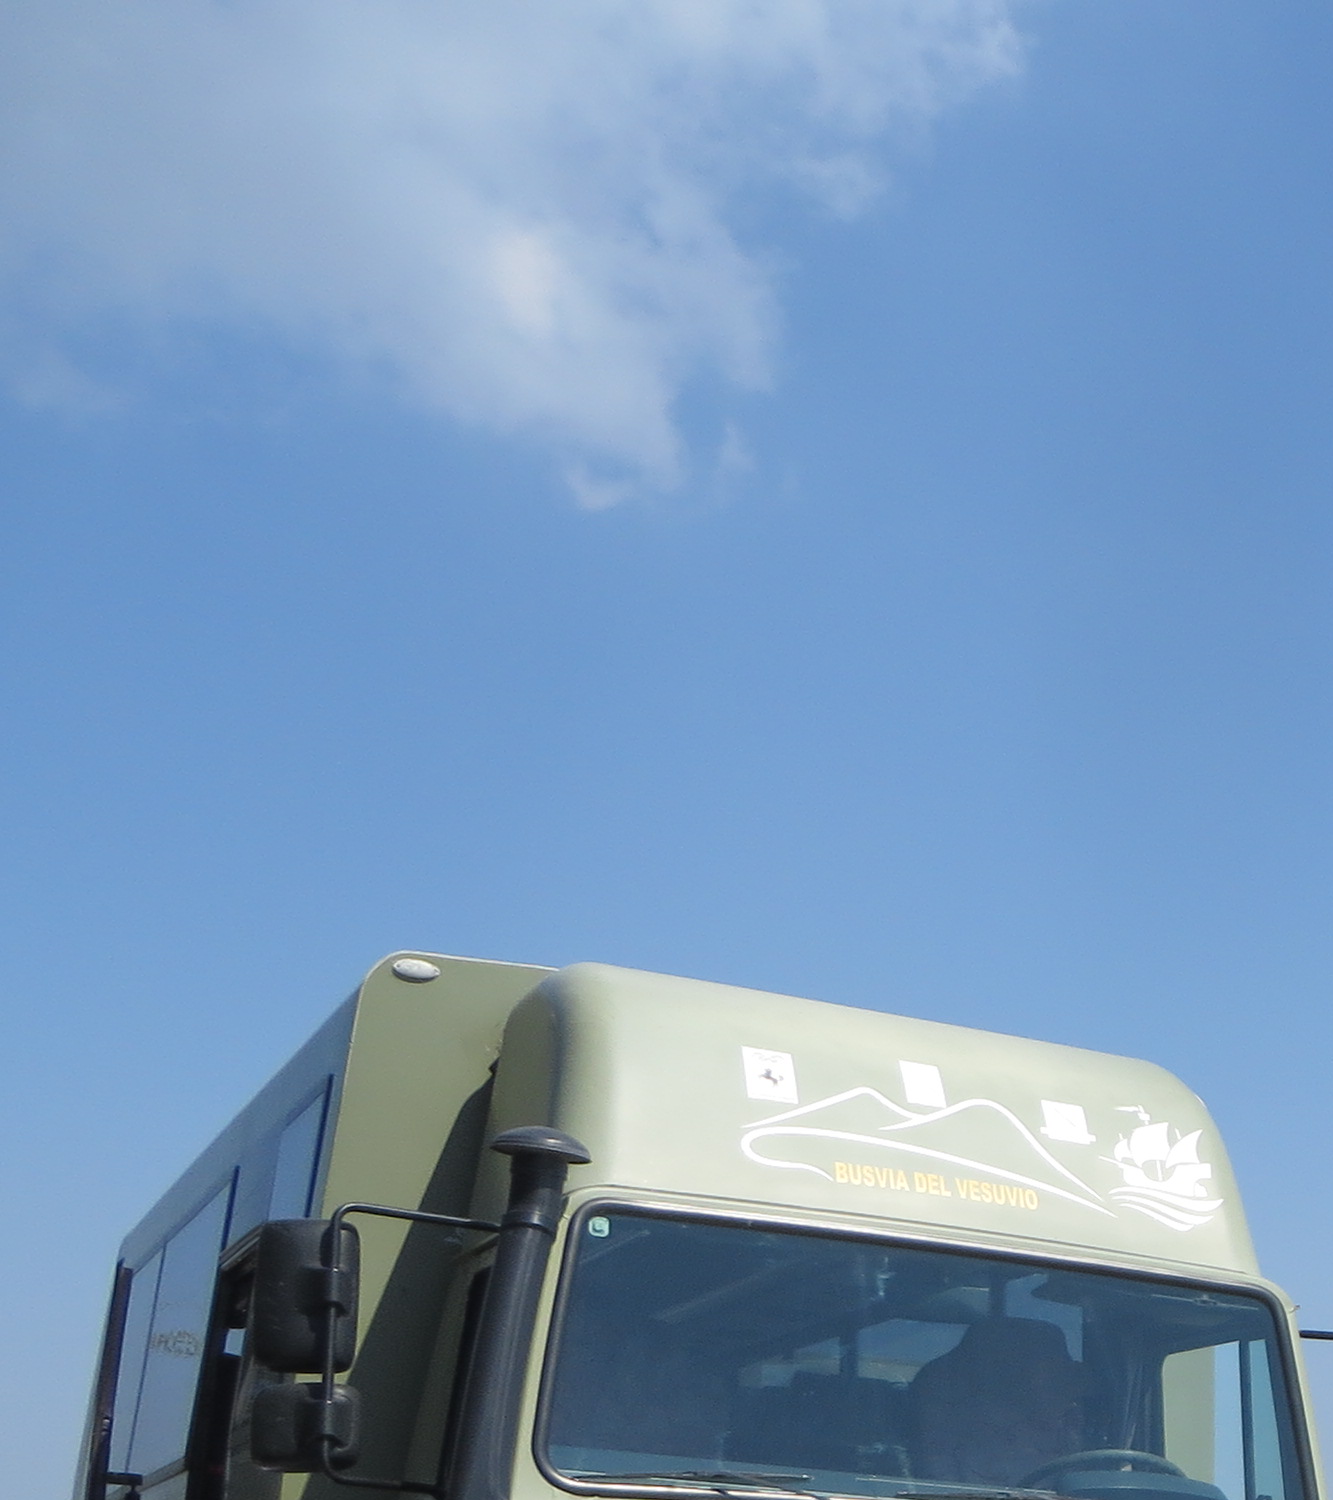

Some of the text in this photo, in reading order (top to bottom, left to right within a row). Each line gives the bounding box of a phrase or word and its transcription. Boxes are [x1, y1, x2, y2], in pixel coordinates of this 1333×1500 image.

[834, 1161, 1040, 1211] BUSVIA DEL VESUVIO
